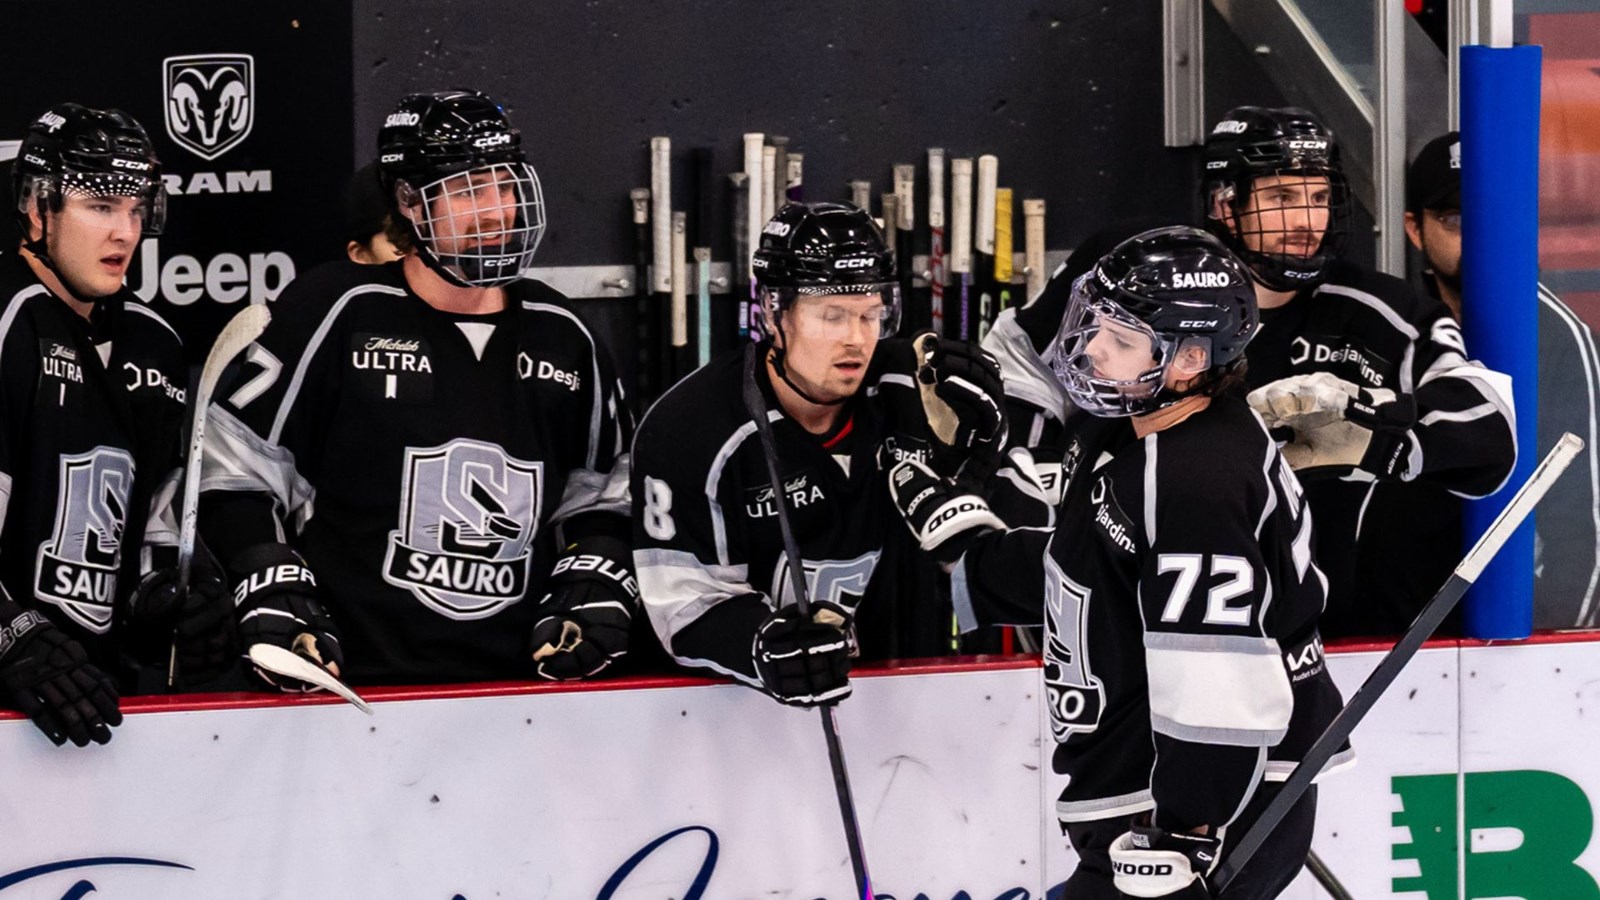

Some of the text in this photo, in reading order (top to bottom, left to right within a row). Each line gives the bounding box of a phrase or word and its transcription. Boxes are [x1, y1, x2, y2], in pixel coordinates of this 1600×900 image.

[384, 111, 420, 128] SAURO
[1213, 119, 1248, 134] SAURO
[473, 134, 511, 147] CCM
[1288, 140, 1328, 150] CCM
[24, 154, 46, 166] CCM
[112, 158, 150, 171] CCM
[381, 153, 404, 163] CCM
[1206, 160, 1228, 169] CCM
[161, 170, 272, 195] RAM
[483, 256, 517, 268] CCM
[834, 257, 875, 270] CCM
[133, 238, 296, 307] Jeep
[1172, 271, 1230, 290] SAURO
[1284, 269, 1322, 280] CCM
[1178, 319, 1219, 329] CCM
[43, 356, 84, 384] ULTRA
[352, 351, 432, 373] ULTRA
[537, 360, 581, 391] Desj
[644, 475, 676, 541] 8
[745, 485, 825, 518] ULRA
[405, 552, 516, 595] SAURO
[1157, 553, 1254, 626] 72
